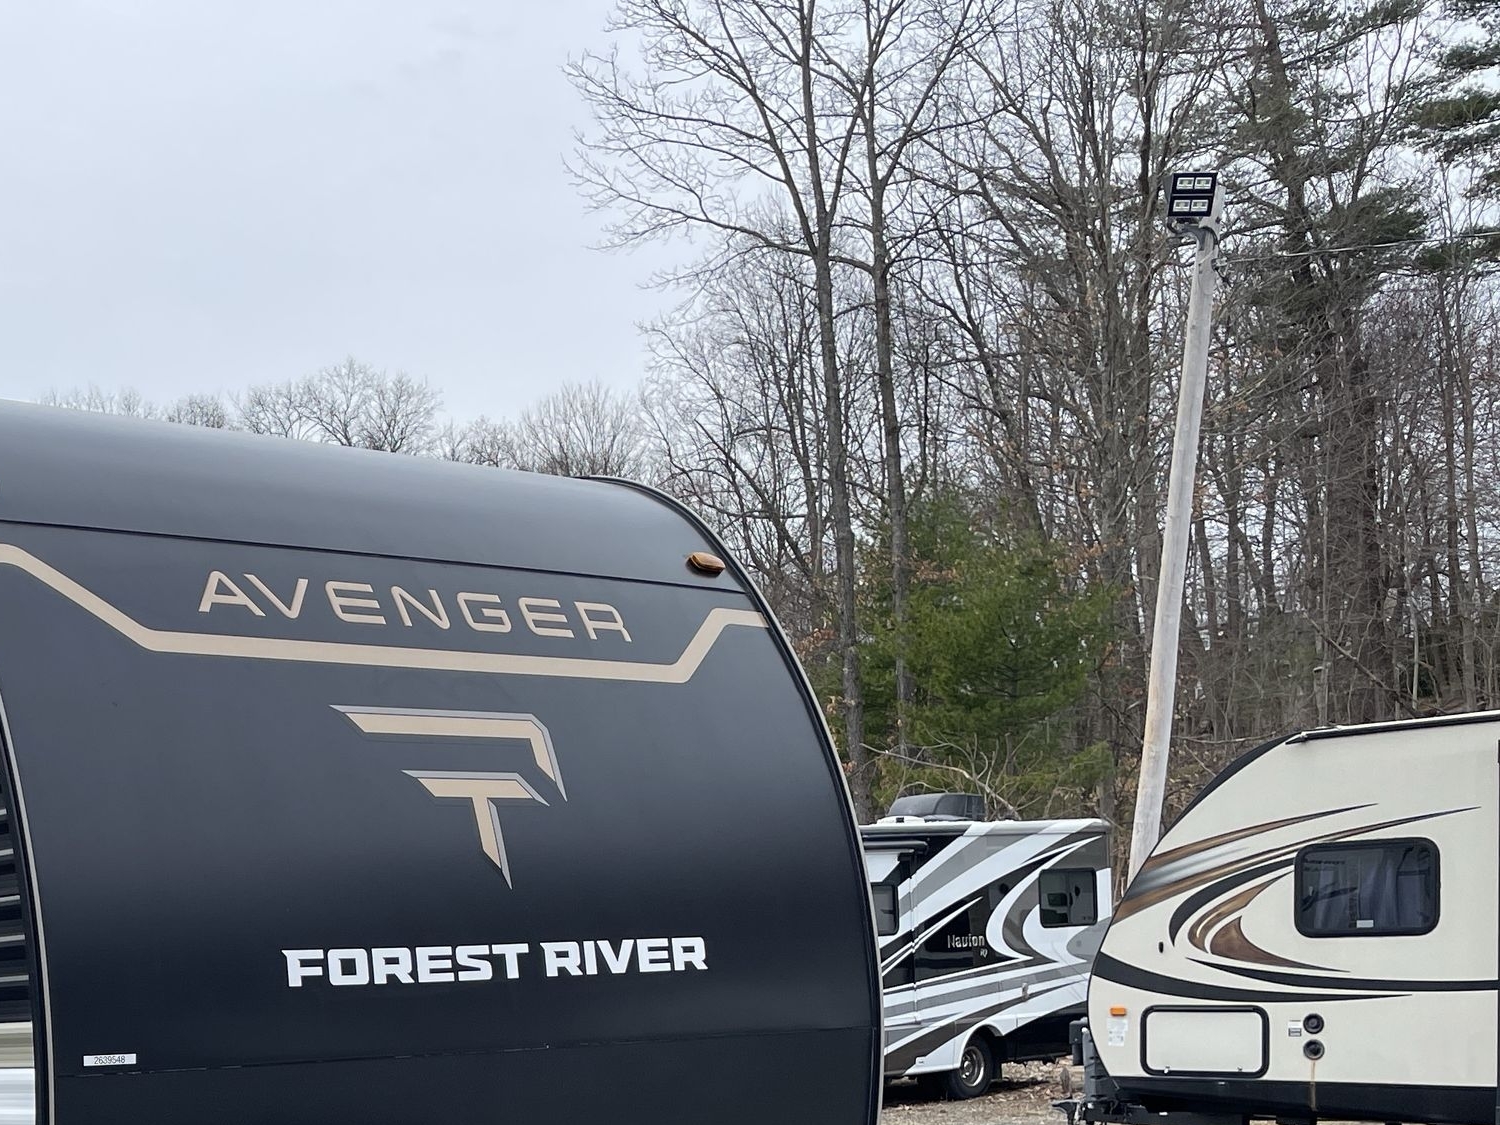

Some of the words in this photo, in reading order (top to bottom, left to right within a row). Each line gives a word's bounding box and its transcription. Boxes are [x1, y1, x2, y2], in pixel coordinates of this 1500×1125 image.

[197, 570, 632, 643] AVENGER
[281, 942, 529, 988] FOREST
[539, 936, 709, 978] RIVER
